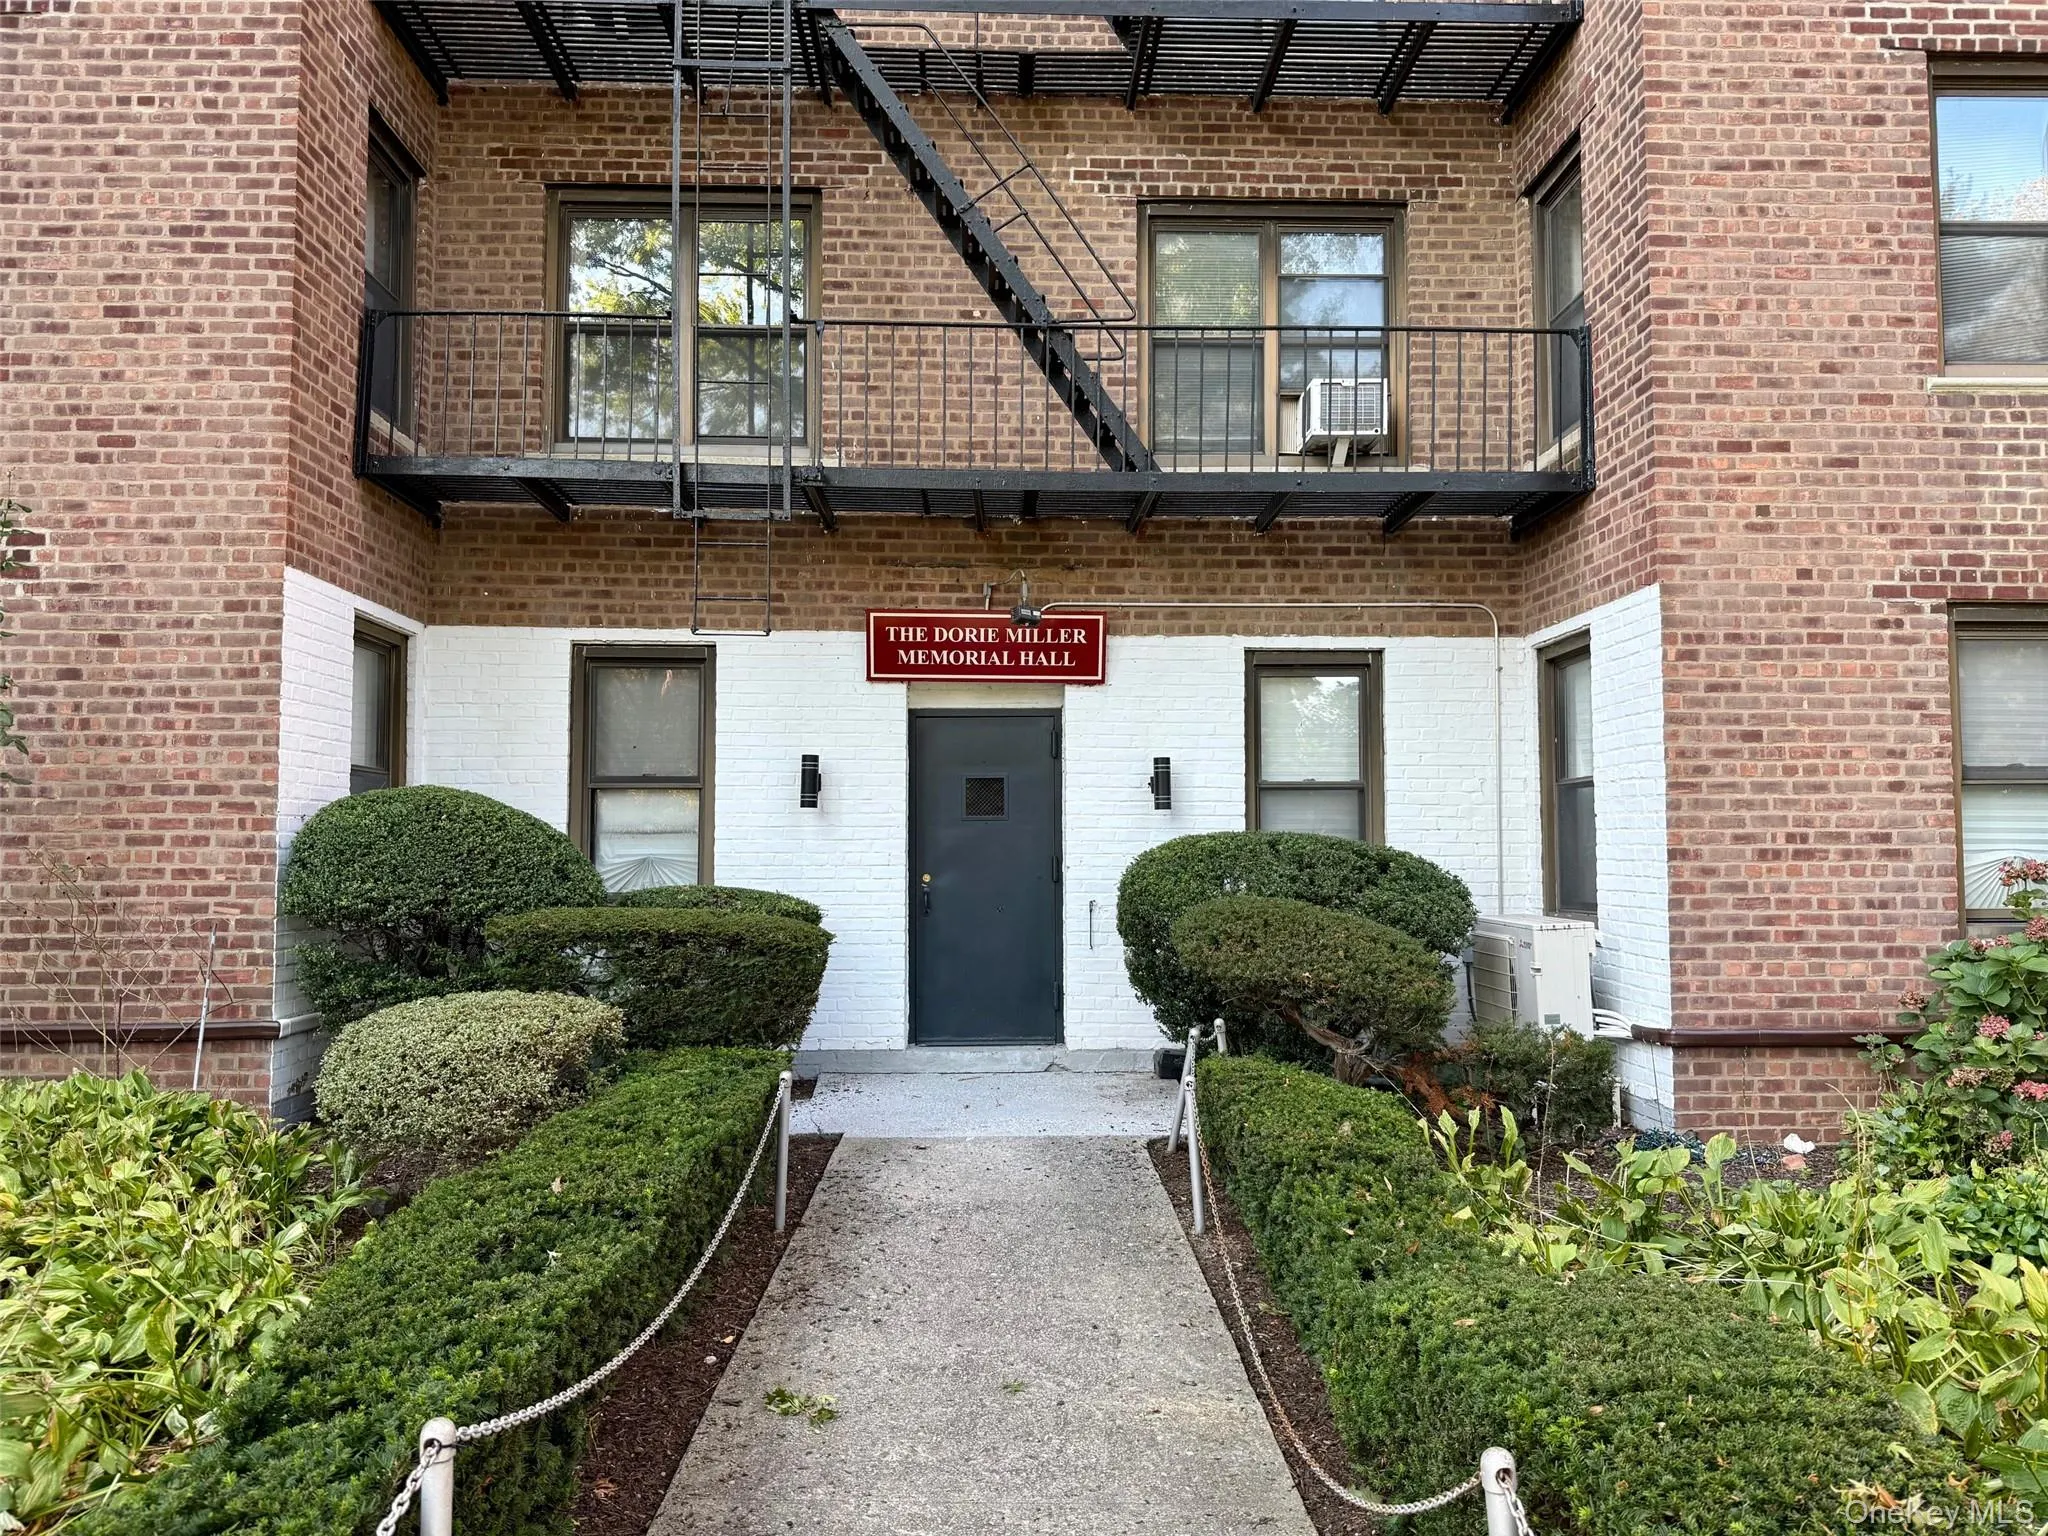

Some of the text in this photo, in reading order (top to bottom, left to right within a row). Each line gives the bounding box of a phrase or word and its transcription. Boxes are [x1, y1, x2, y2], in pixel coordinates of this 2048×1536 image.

[885, 627, 1087, 644] THE DORIE MILLER
[897, 650, 1075, 666] MEMORIAL HALL
